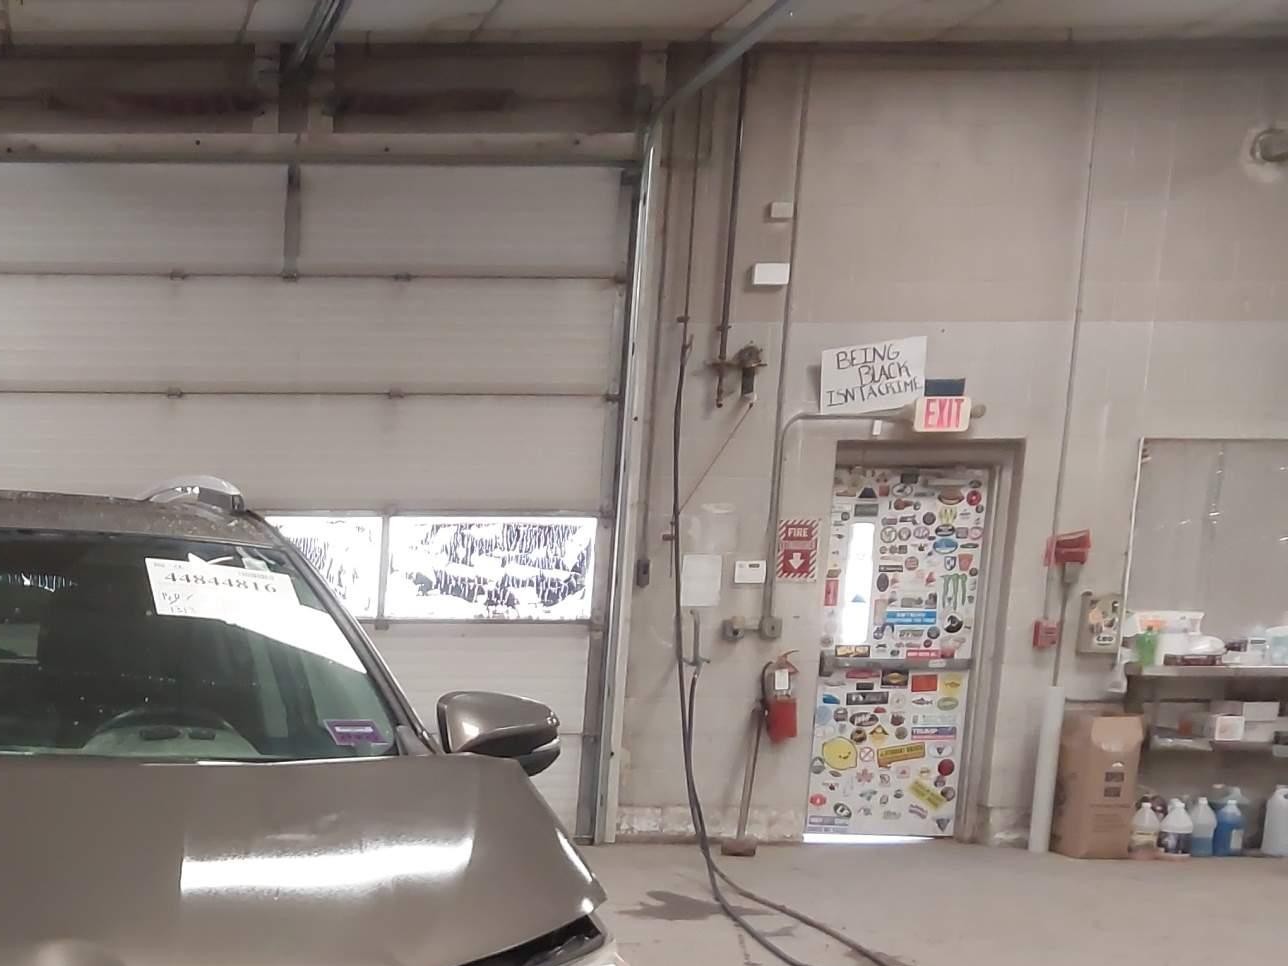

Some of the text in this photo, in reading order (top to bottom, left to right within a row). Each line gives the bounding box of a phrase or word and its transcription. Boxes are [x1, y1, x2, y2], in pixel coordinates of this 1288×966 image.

[836, 344, 900, 370] BEING
[858, 361, 911, 387] BLACK
[923, 398, 964, 430] EXIT
[787, 527, 809, 537] FIRE
[164, 572, 277, 593] 44844816
